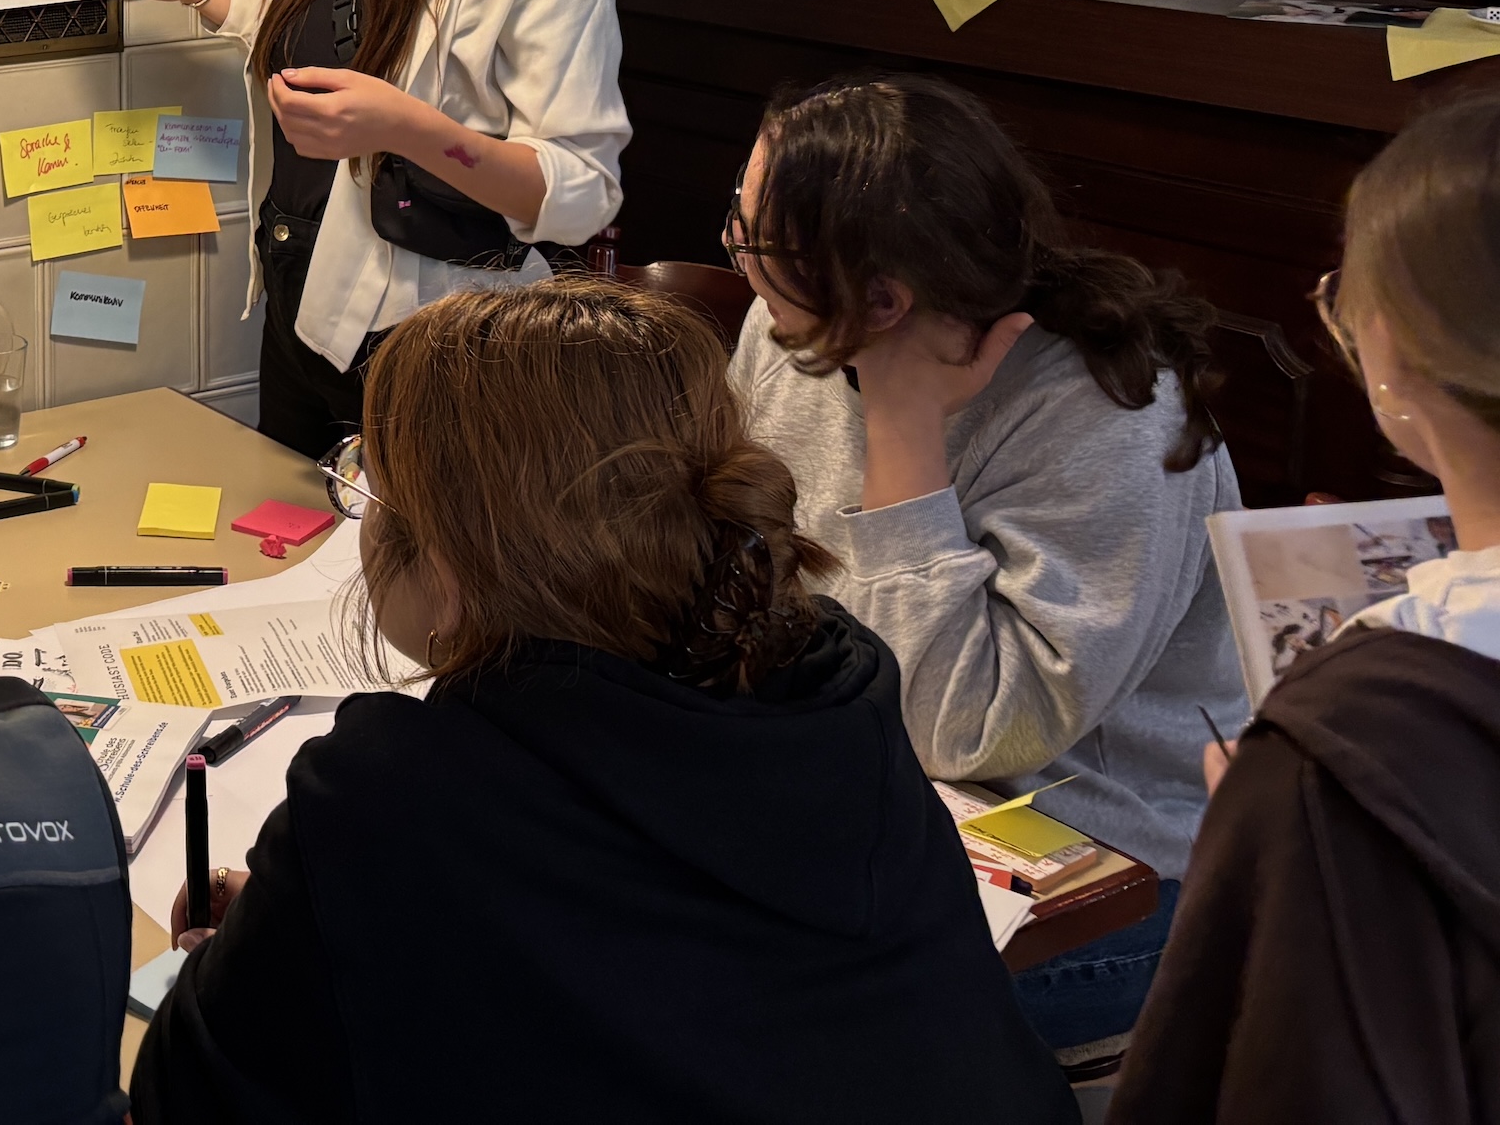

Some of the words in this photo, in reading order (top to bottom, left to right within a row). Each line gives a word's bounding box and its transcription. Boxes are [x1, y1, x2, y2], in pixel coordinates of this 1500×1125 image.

[19, 133, 60, 159] Sprache
[69, 290, 124, 308] Kommunikativ
[98, 643, 116, 664] CODE
[106, 665, 130, 701] HUSIAST
[115, 722, 168, 803] w.Schule-des-Schreibens.de
